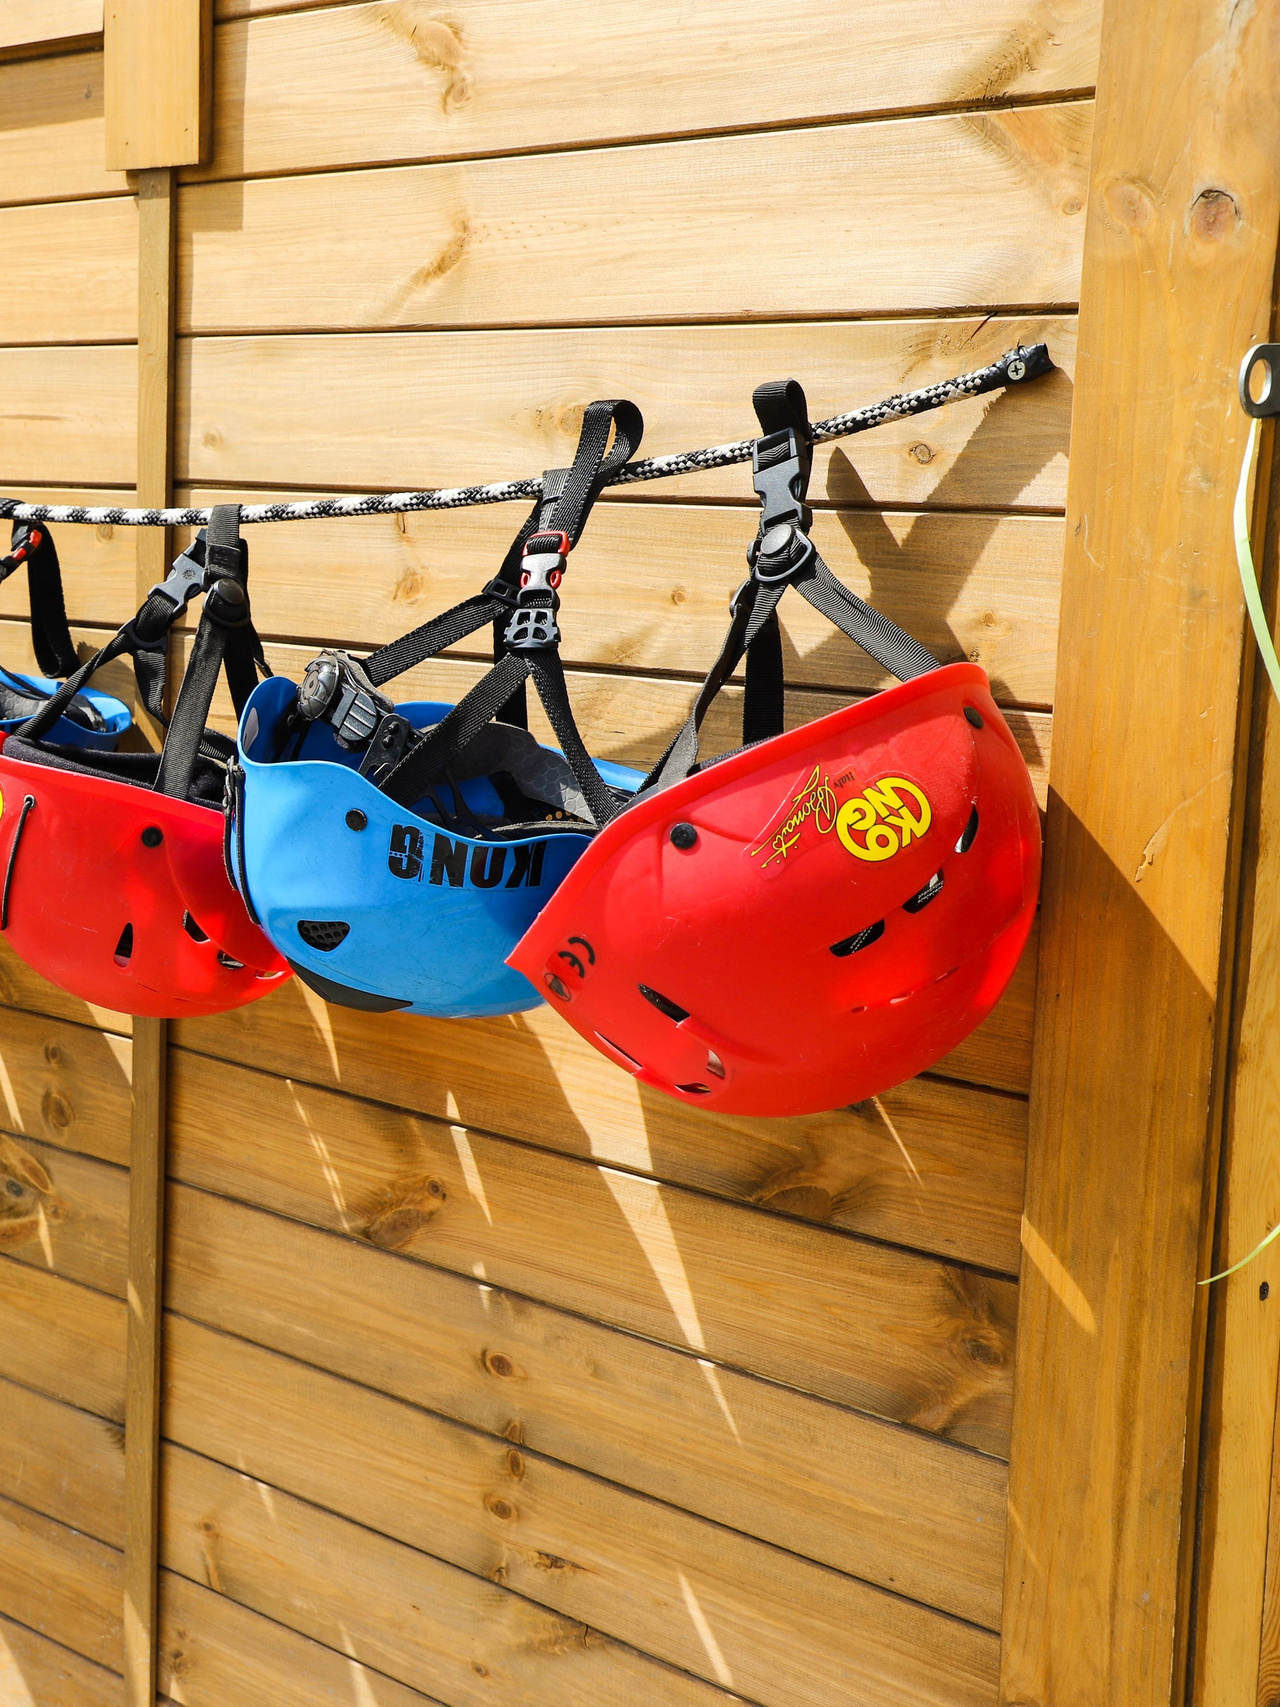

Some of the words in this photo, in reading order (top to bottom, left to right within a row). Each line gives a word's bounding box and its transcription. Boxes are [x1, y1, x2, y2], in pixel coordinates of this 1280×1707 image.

[832, 771, 856, 791] Italy
[836, 776, 932, 862] KONG
[388, 824, 548, 889] KONG
[558, 937, 596, 979] CE
